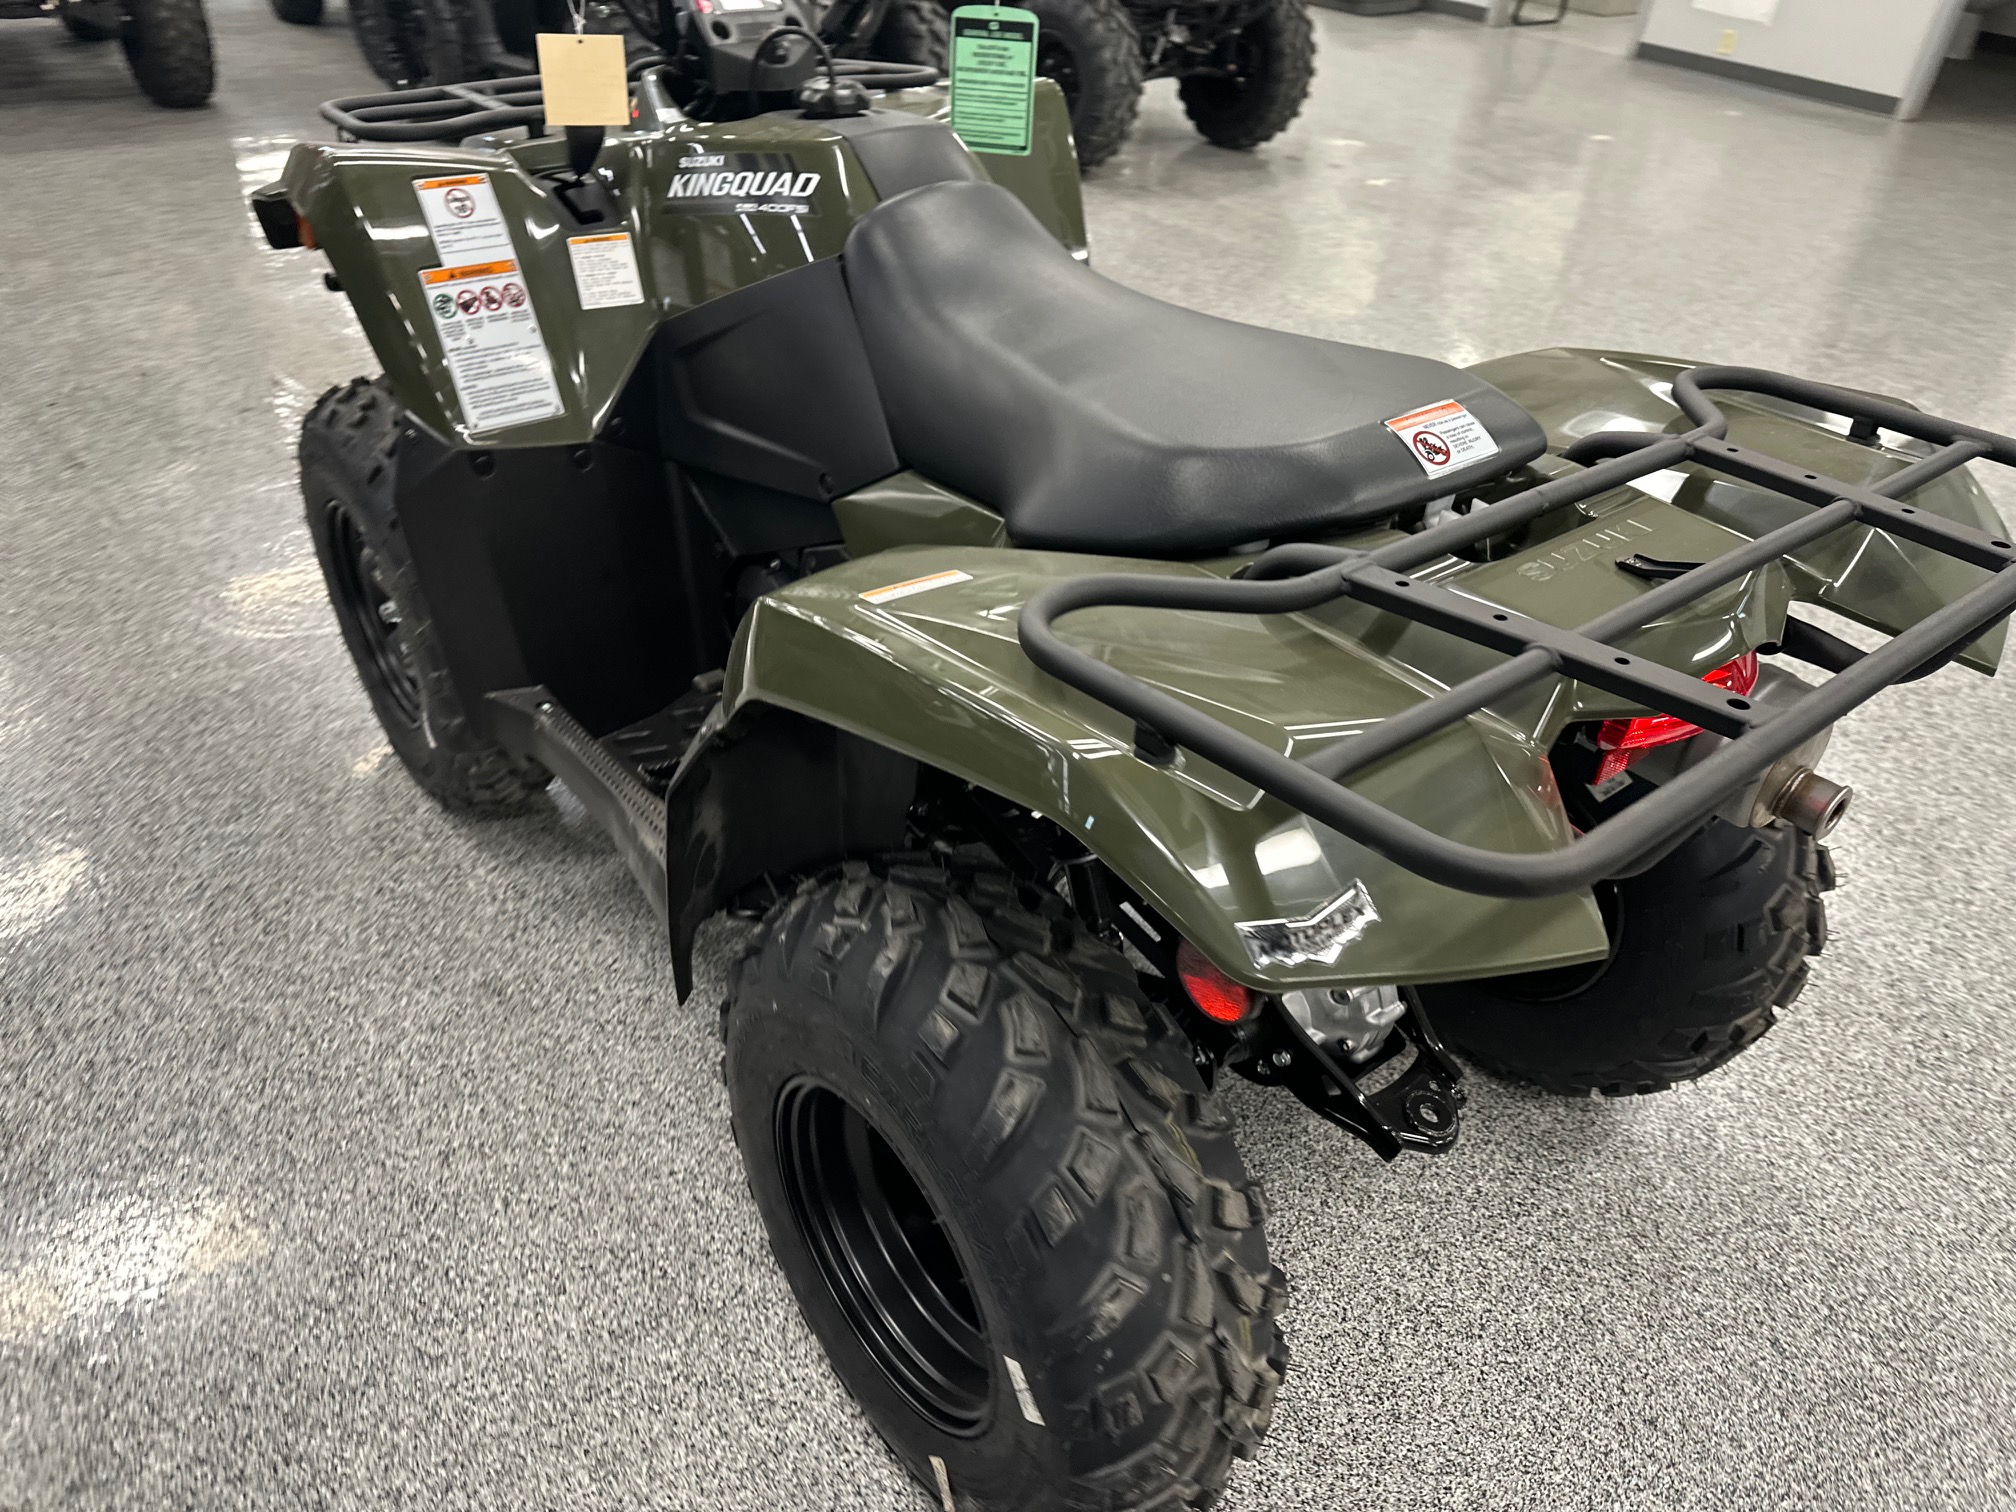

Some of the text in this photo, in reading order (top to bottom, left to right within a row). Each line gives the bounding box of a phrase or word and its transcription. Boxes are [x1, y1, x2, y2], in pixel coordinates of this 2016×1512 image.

[678, 154, 726, 168] SUZUKI
[666, 171, 822, 198] KINGQUAD
[1516, 519, 1653, 581] SUZUKI
